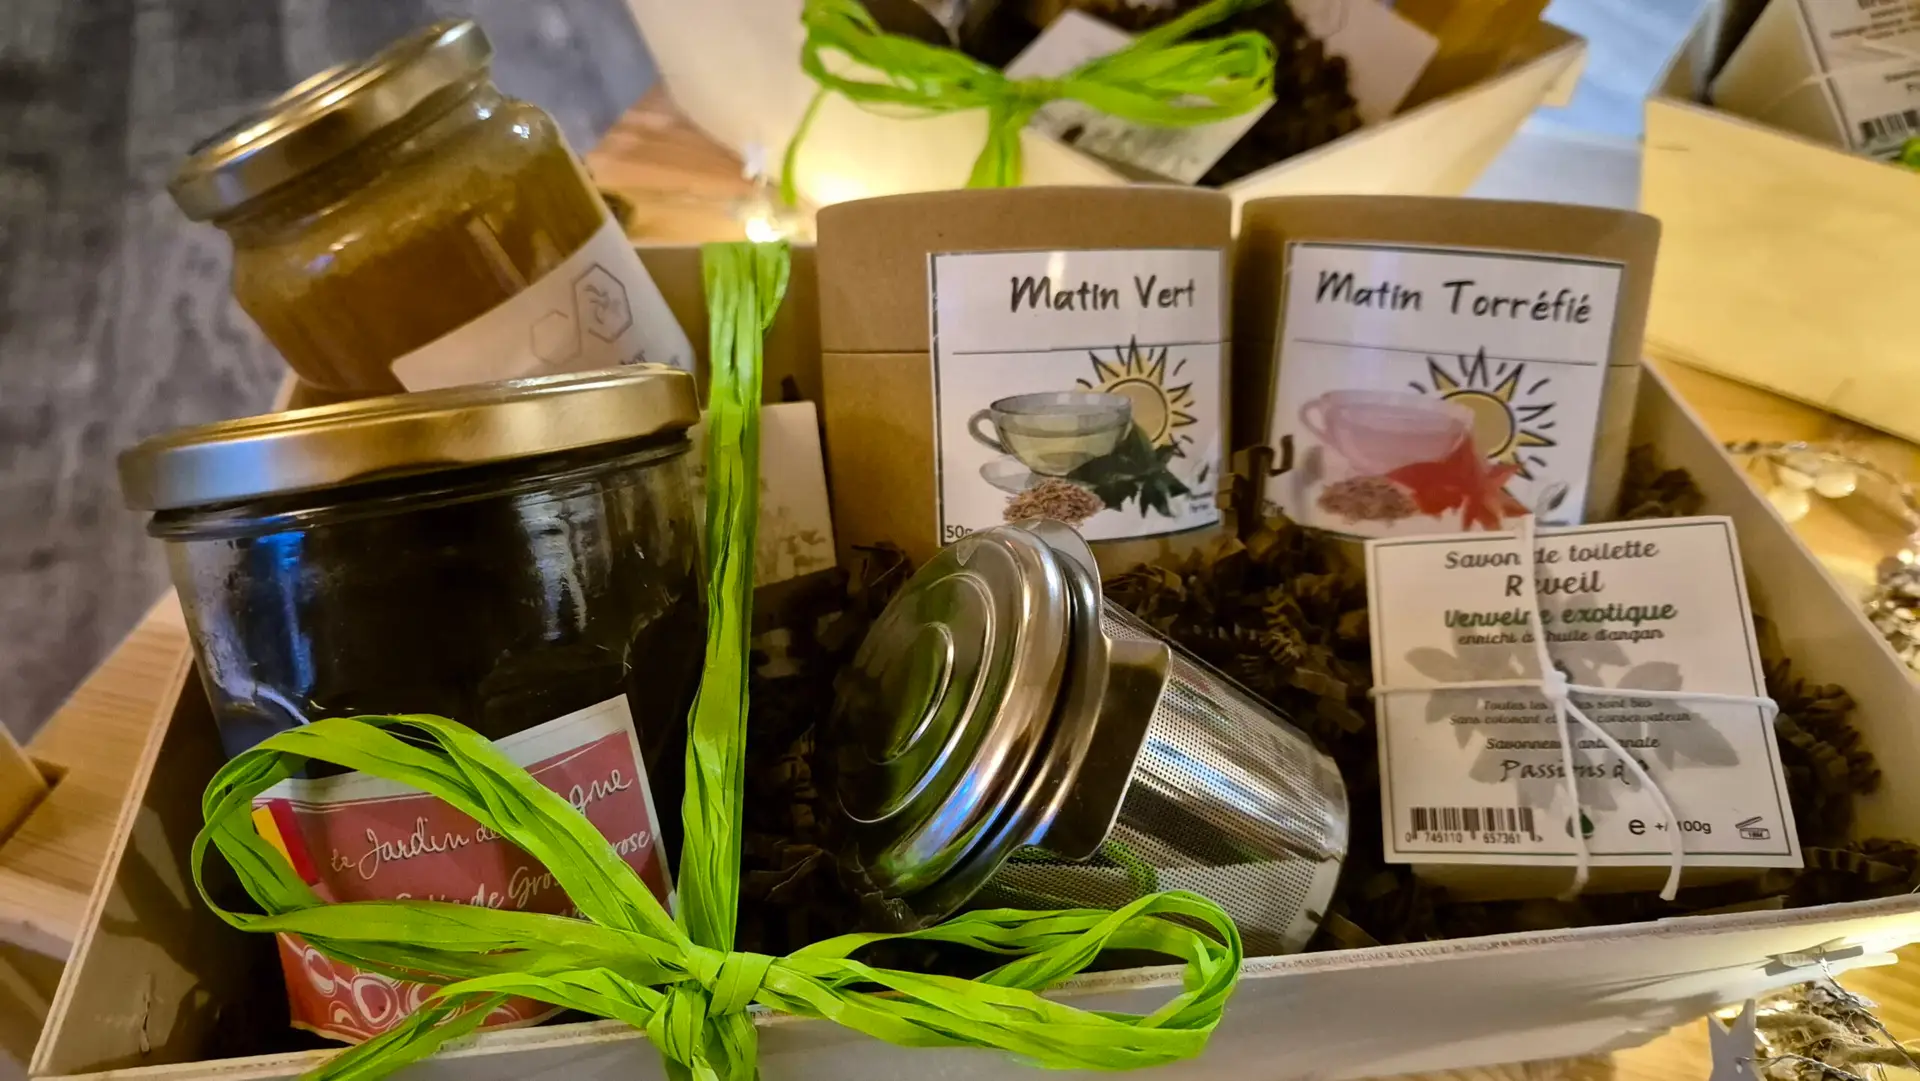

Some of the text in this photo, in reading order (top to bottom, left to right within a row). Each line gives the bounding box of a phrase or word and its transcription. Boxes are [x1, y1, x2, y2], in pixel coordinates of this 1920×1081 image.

[1010, 274, 1196, 313] Matin Vert
[1315, 270, 1592, 325] Matin Torréfié
[1444, 541, 1660, 569] Savon de toilette
[1563, 603, 1679, 626] exotique
[1500, 758, 1606, 783] Passins
[358, 815, 469, 880] Jardin
